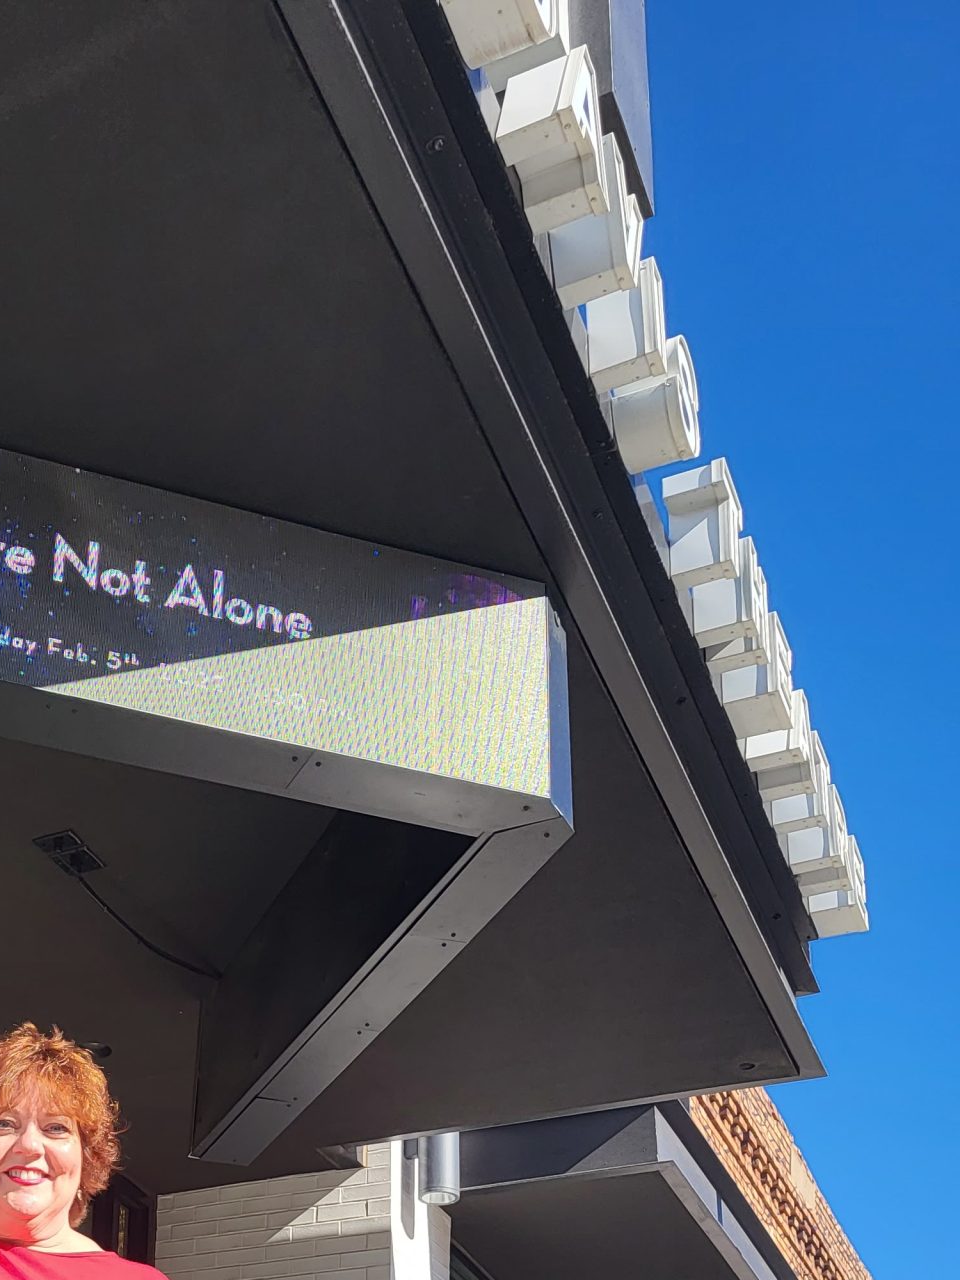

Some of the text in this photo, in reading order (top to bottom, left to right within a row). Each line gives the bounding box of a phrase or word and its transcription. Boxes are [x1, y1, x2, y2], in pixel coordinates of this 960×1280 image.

[52, 532, 151, 603] Not
[164, 563, 314, 640] Alone
[47, 637, 97, 666] Feb.
